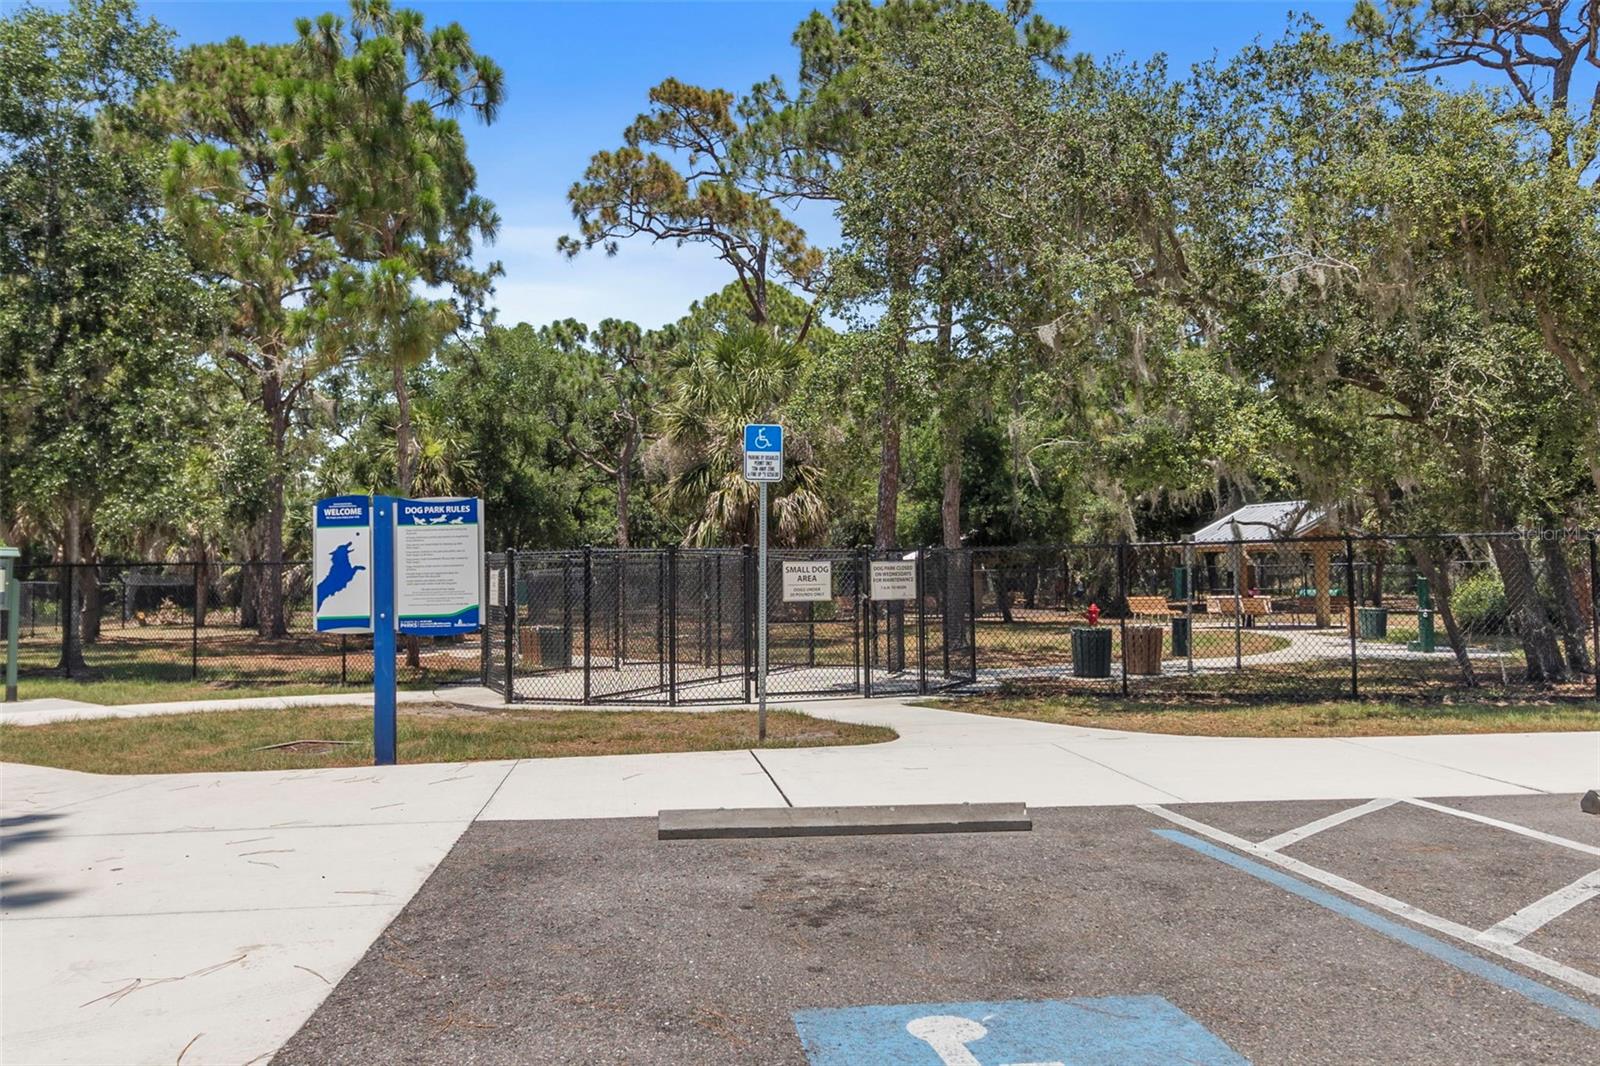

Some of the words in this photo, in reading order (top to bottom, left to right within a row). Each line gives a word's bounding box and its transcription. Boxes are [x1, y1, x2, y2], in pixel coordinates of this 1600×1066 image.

[323, 508, 363, 516] WELCOME
[424, 506, 445, 514] PARK
[446, 505, 471, 513] RULES
[785, 566, 810, 574] SMALL
